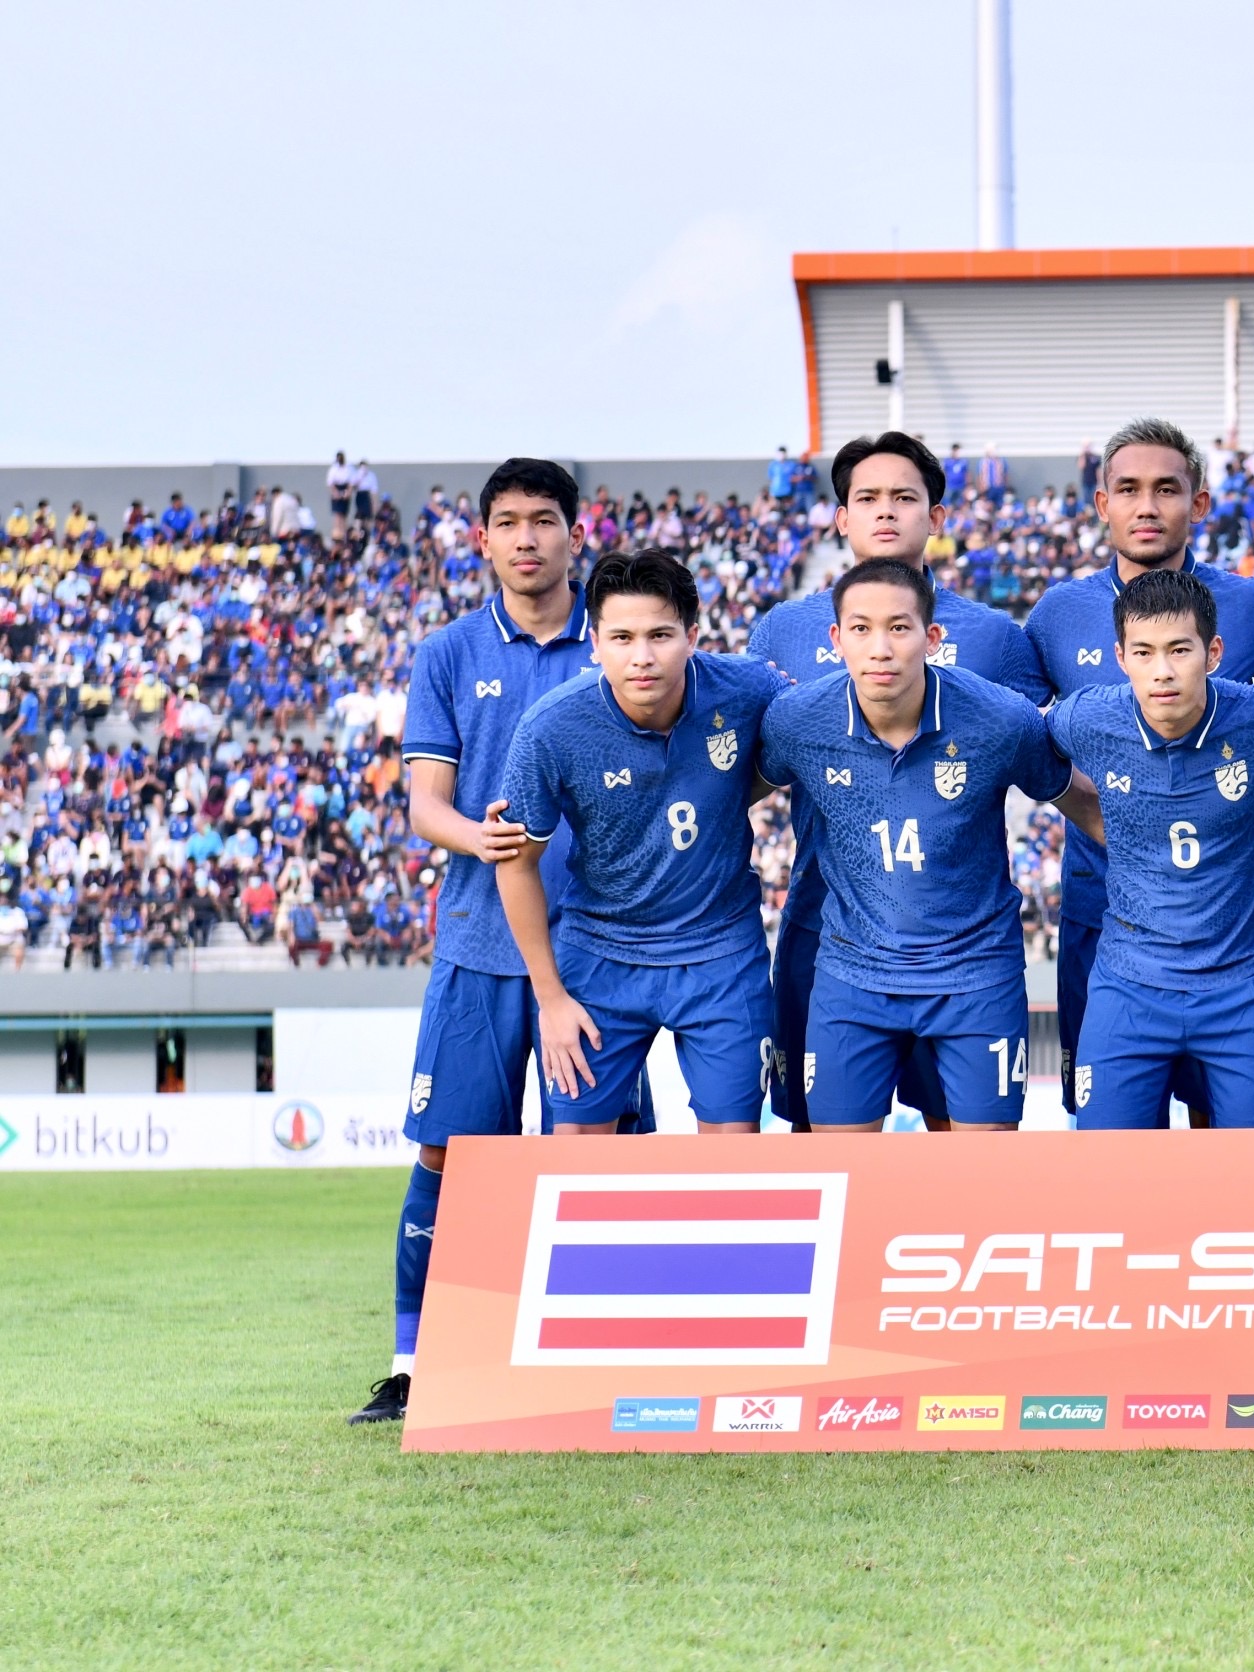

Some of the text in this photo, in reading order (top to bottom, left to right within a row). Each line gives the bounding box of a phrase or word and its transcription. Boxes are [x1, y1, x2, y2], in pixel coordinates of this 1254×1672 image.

[705, 729, 736, 742] THAILAND
[667, 800, 699, 851] 8
[870, 818, 925, 872] 14
[1169, 820, 1201, 869] 6
[988, 1036, 1027, 1097] 14
[35, 1112, 170, 1158] bitkub
[879, 1305, 1132, 1331] FOOTBALL
[948, 1408, 999, 1418] M-150
[1049, 1403, 1103, 1422] Chang
[1127, 1405, 1206, 1419] TOYOTA
